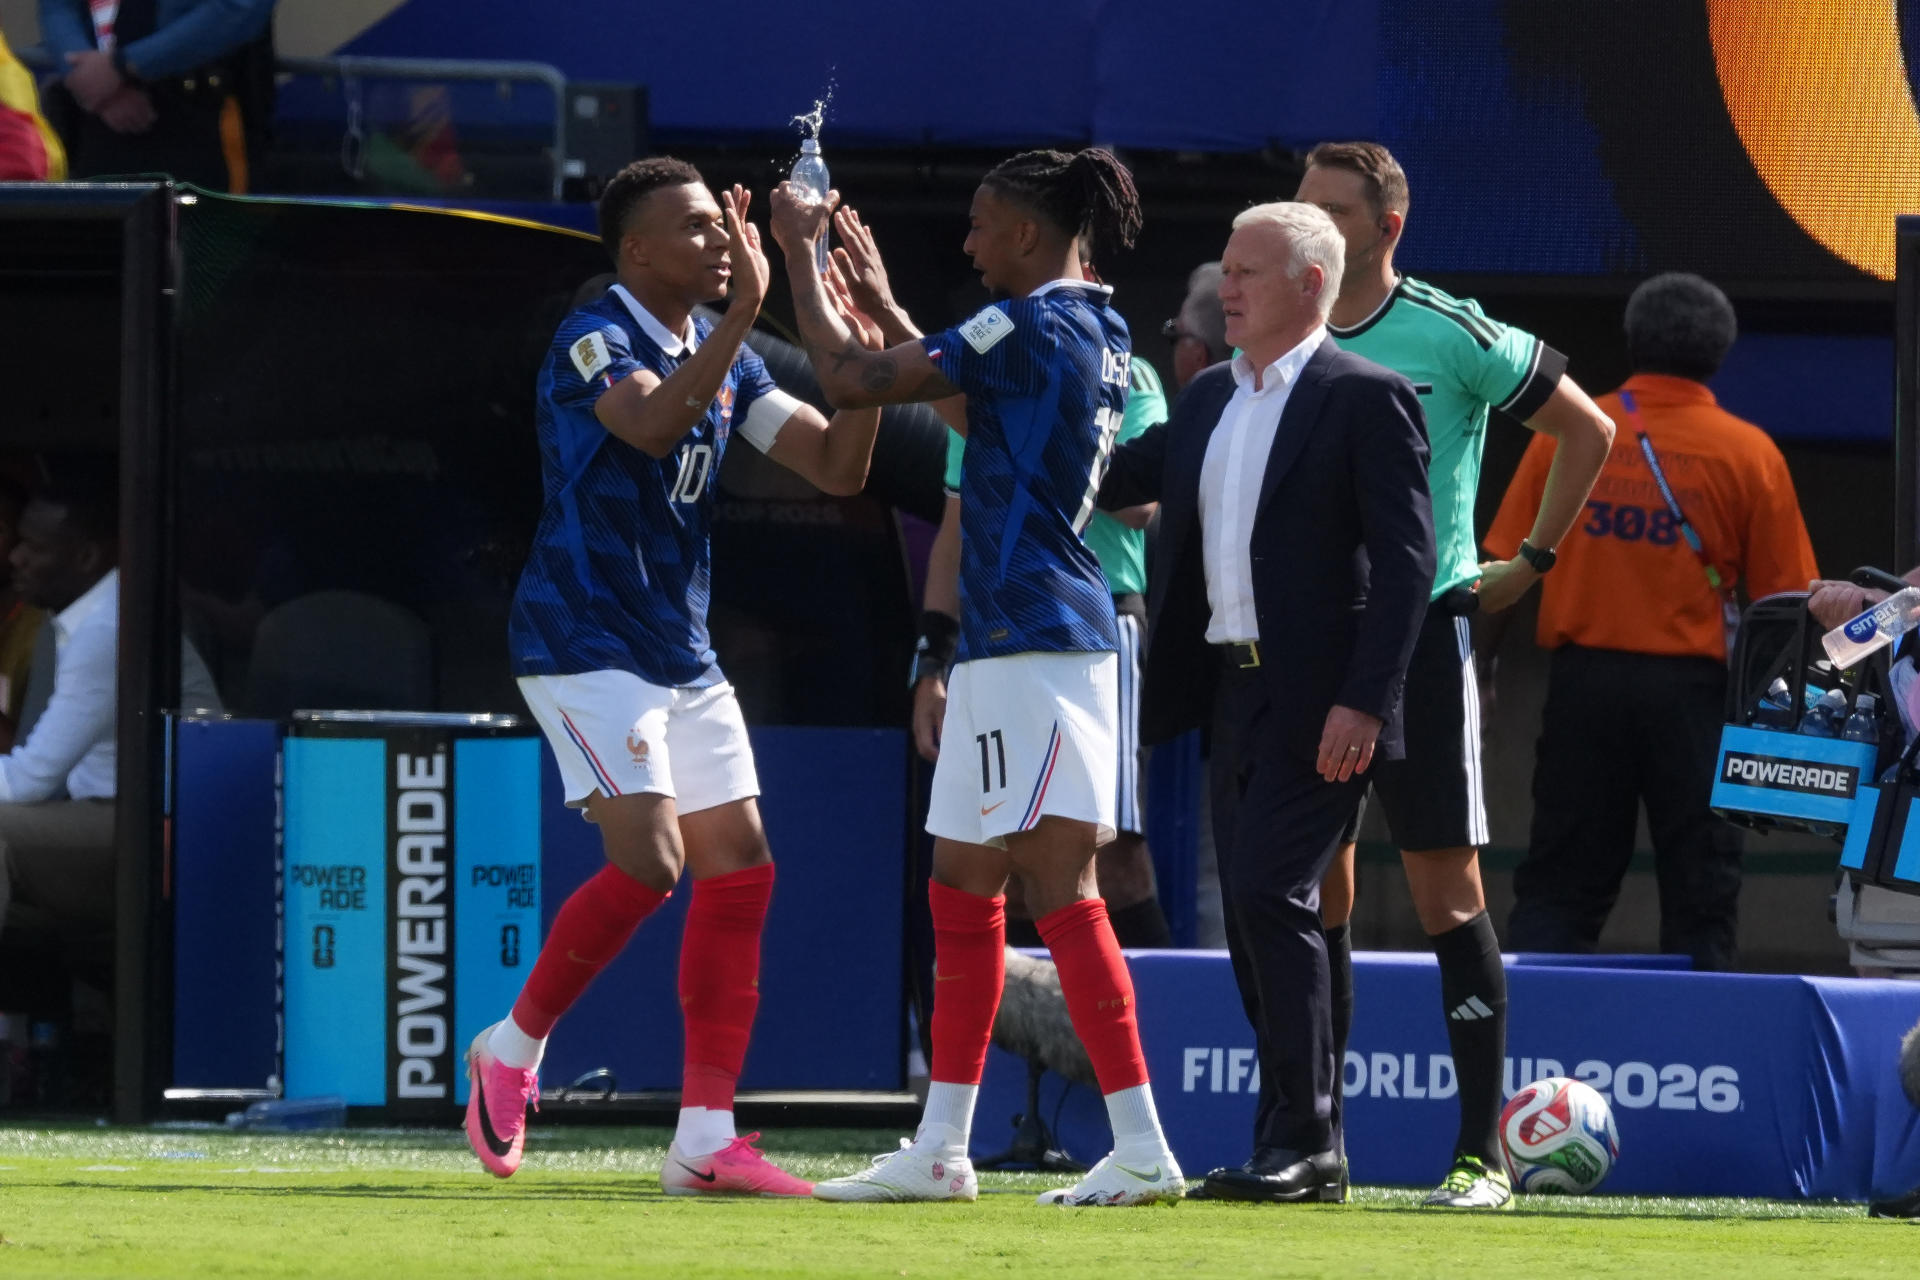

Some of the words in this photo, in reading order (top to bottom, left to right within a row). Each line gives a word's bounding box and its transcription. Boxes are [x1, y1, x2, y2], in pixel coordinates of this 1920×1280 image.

[669, 444, 712, 503] 10
[1584, 500, 1679, 546] 308
[1851, 601, 1898, 635] smart
[976, 729, 1006, 793] 11
[1727, 757, 1850, 792] POWERADE
[291, 865, 366, 887] POWER
[320, 889, 367, 911] ADE
[397, 752, 447, 1099] POWERADE
[1342, 1050, 1459, 1099] ORLD
[1575, 1060, 1740, 1112] 2026
